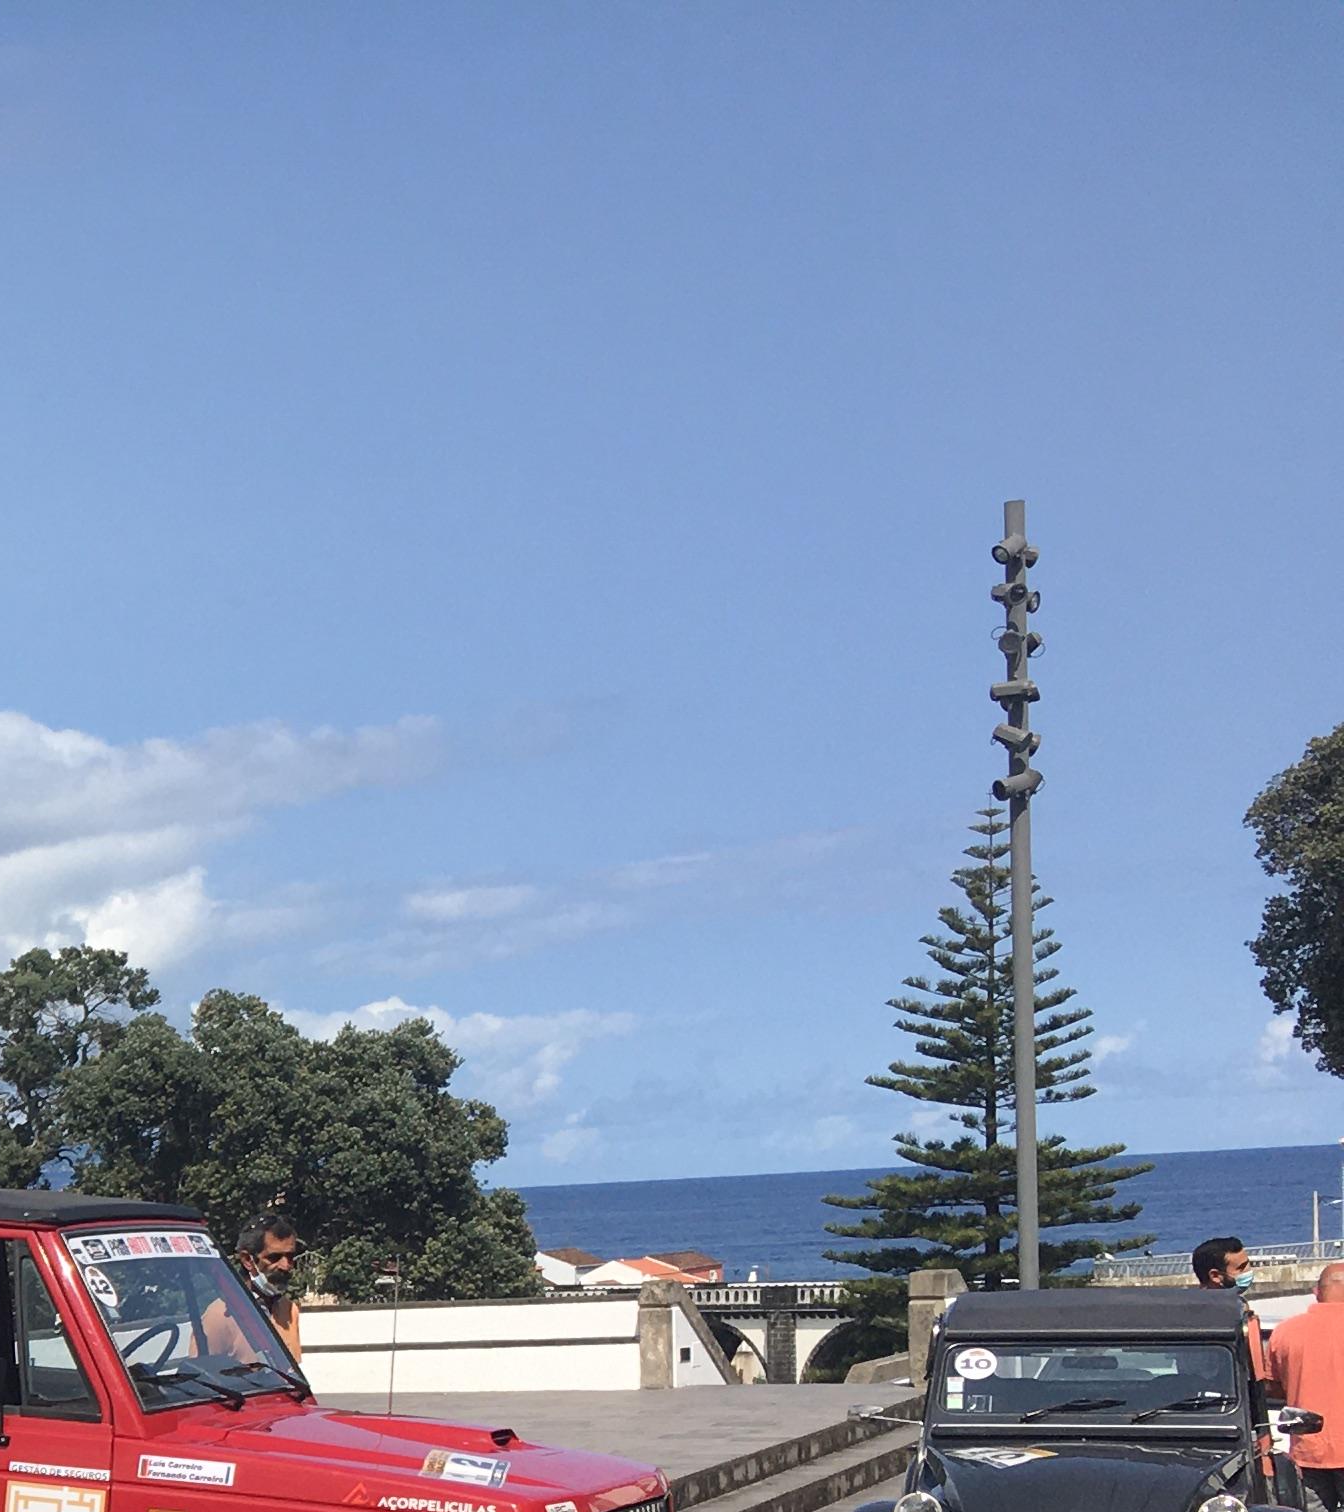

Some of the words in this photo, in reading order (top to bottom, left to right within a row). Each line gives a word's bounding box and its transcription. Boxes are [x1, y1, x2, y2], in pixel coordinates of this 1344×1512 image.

[90, 1279, 113, 1295] 12
[960, 1359, 991, 1369] 10
[64, 1469, 108, 1481] SEGUROS
